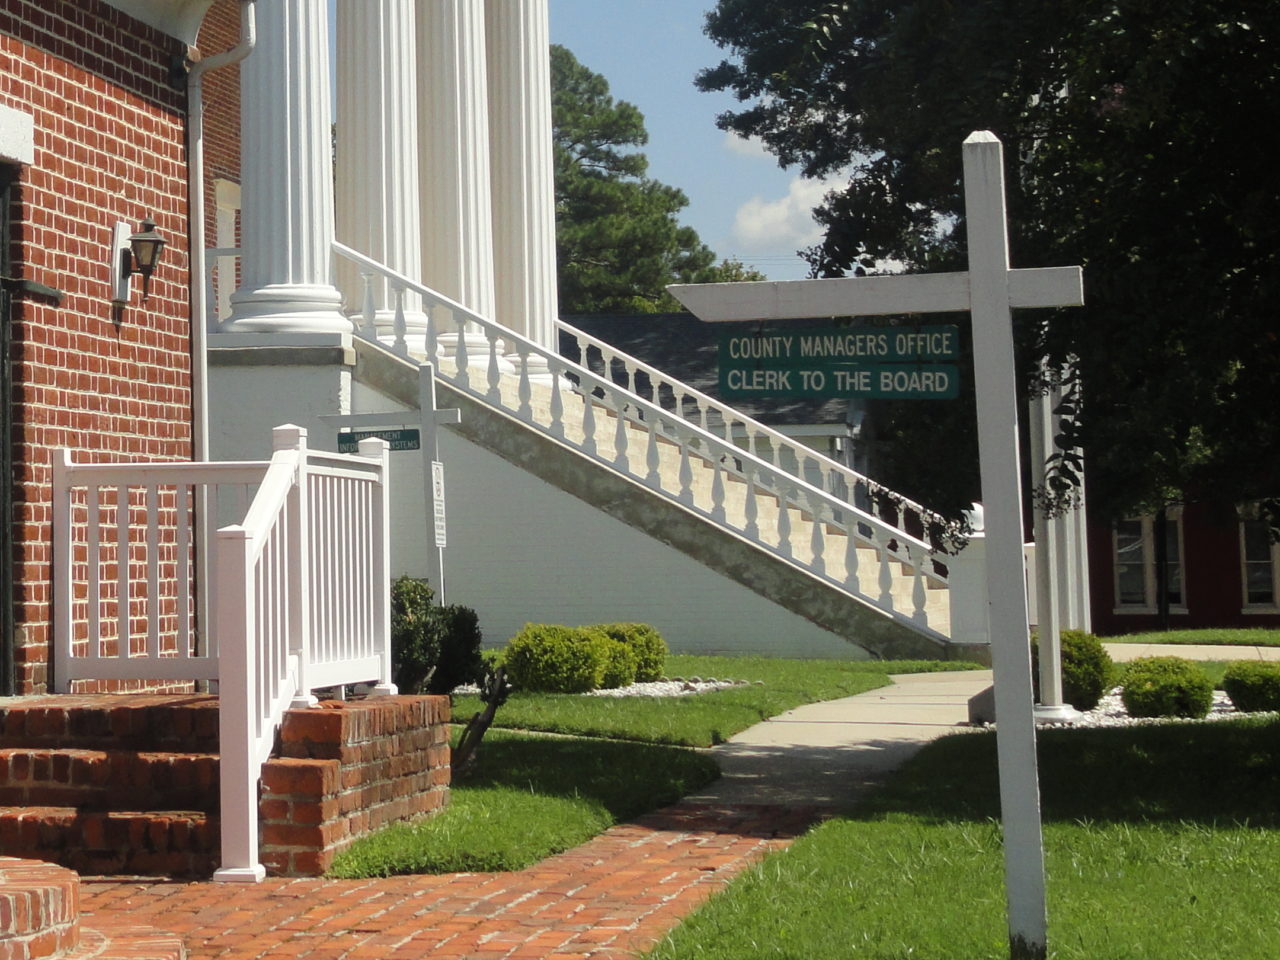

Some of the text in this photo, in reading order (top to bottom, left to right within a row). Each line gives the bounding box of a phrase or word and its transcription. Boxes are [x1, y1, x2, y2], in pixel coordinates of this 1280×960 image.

[729, 333, 953, 359] COUNTY MANAGERS OFFICE
[727, 370, 949, 392] CLERK TO THE BOARD
